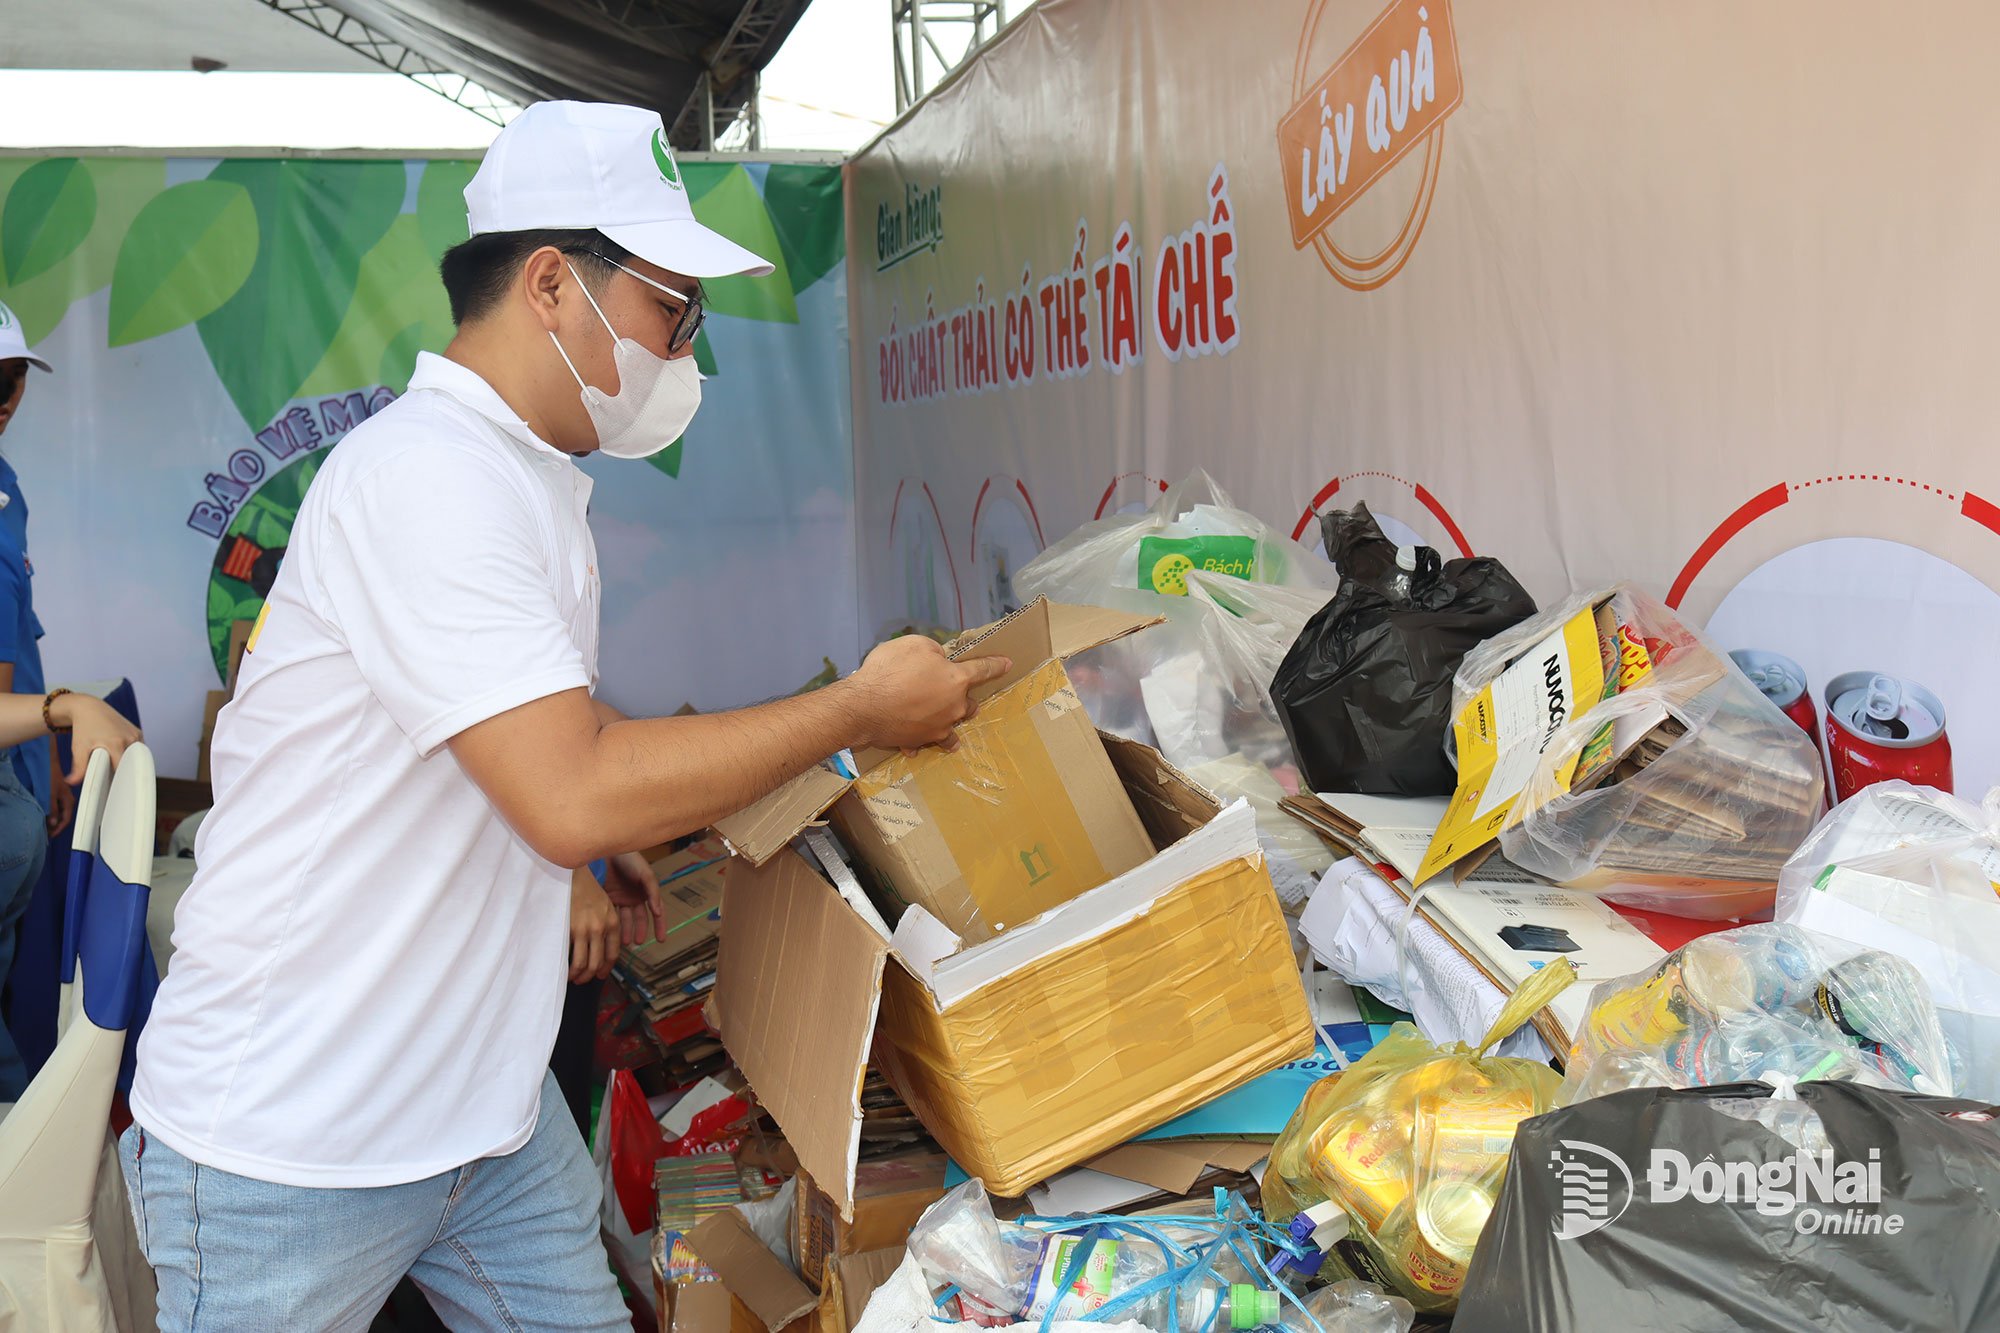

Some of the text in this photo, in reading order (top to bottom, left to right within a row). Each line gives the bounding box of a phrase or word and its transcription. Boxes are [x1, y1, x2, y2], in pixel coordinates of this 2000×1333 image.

[1302, 6, 1435, 217] LẤY QUÀ
[878, 202, 902, 262] Gian
[909, 292, 946, 398] CHẤT
[951, 282, 998, 391] THẢI
[1004, 270, 1035, 381] CÓ
[1040, 226, 1089, 373] THỂ
[1095, 231, 1143, 366] TÁI
[1158, 174, 1236, 352] CHẾ
[187, 449, 265, 539] BẢO
[256, 407, 322, 460] VỆ
[1202, 558, 1244, 575] Bách
